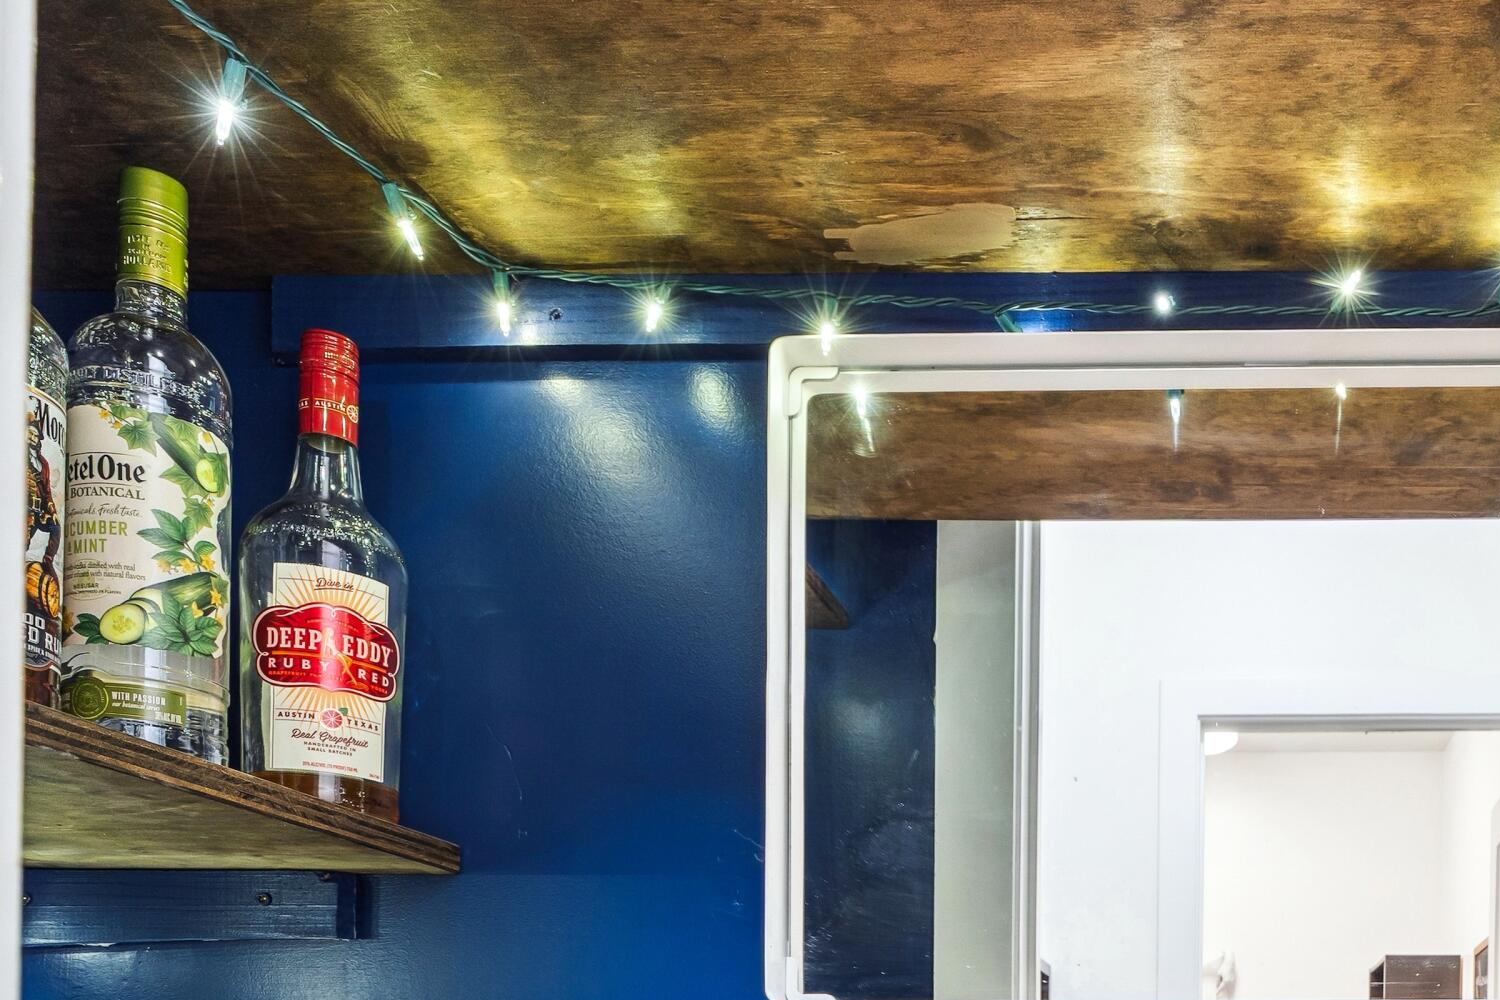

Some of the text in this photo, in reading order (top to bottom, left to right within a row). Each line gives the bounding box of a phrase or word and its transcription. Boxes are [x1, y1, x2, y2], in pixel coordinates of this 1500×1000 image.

[65, 453, 147, 483] etel One
[69, 486, 146, 501] BOTANICAL
[64, 520, 128, 537] UCUMBER
[73, 538, 107, 554] MINT
[45, 631, 62, 655] RU
[266, 626, 392, 668] DEEP EDDY
[268, 657, 389, 688] RUBY RED
[111, 691, 166, 706] WITH PASSION
[277, 711, 379, 732] AUSTIN TEXAS
[291, 728, 369, 748] Real Grapefruit
[303, 741, 347, 751] HANDCRAFTED
